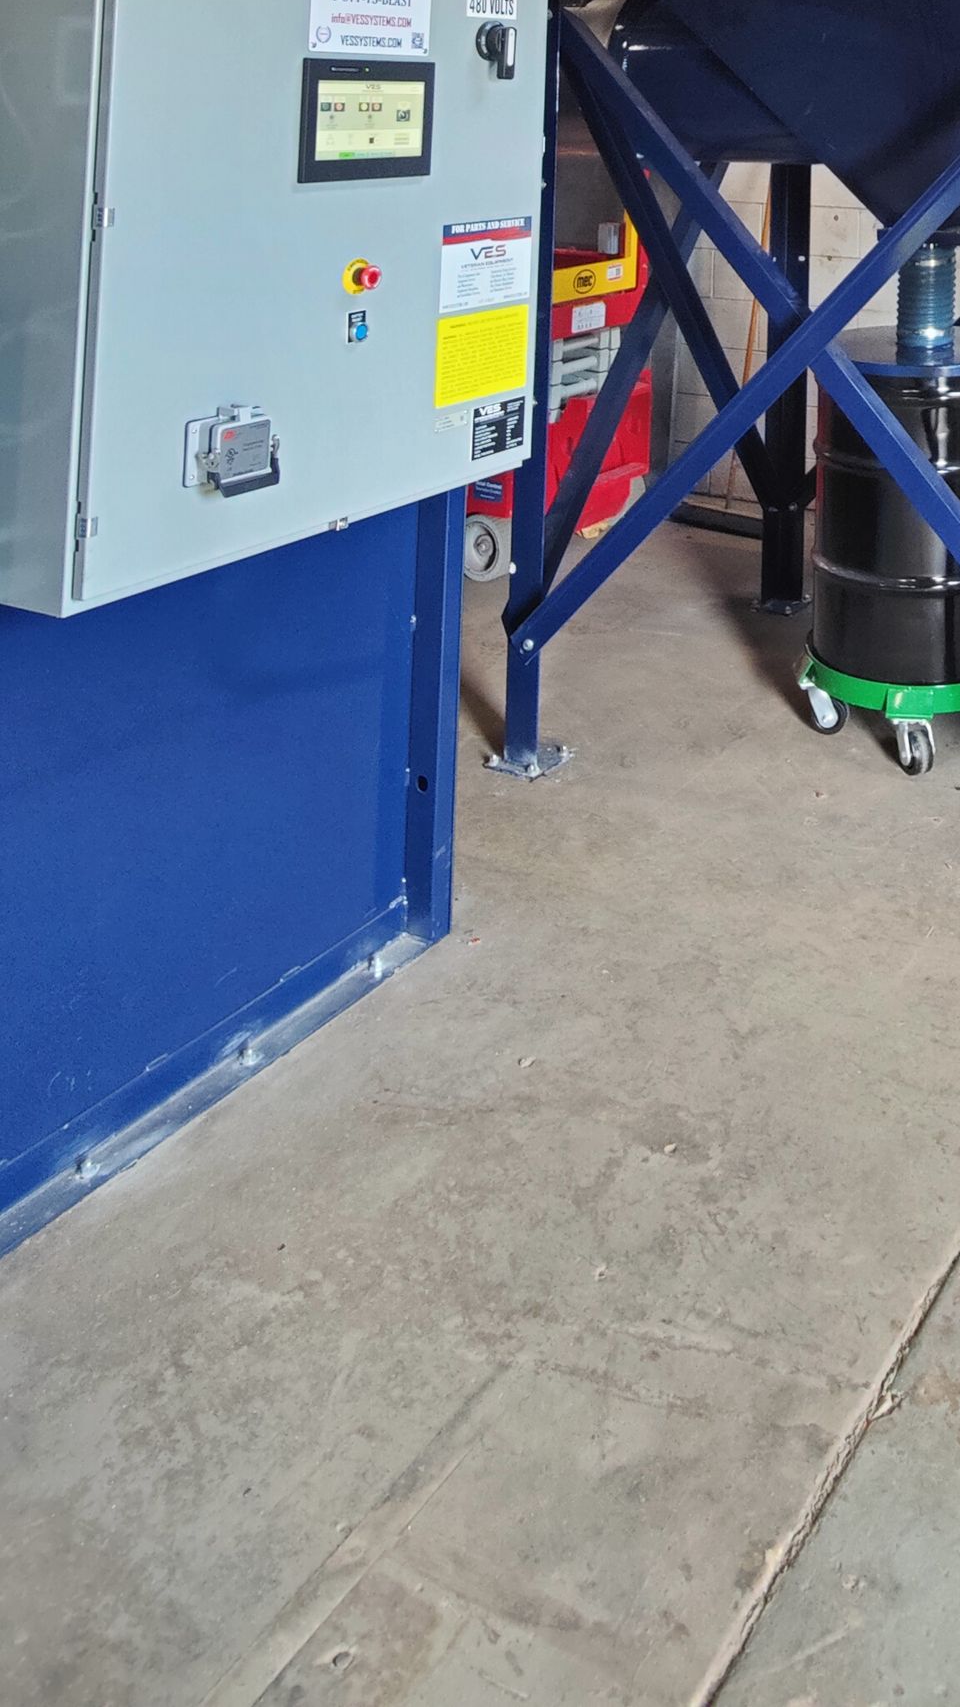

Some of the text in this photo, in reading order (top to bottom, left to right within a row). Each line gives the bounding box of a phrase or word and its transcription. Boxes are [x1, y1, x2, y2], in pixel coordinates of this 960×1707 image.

[331, 12, 412, 28] info@VESSYSTEMS.COM
[340, 35, 402, 48] VESSYSTEMS.COM
[451, 224, 465, 234] FOR
[465, 222, 486, 233] PARTS
[486, 220, 499, 230] AND
[470, 244, 507, 260] VES
